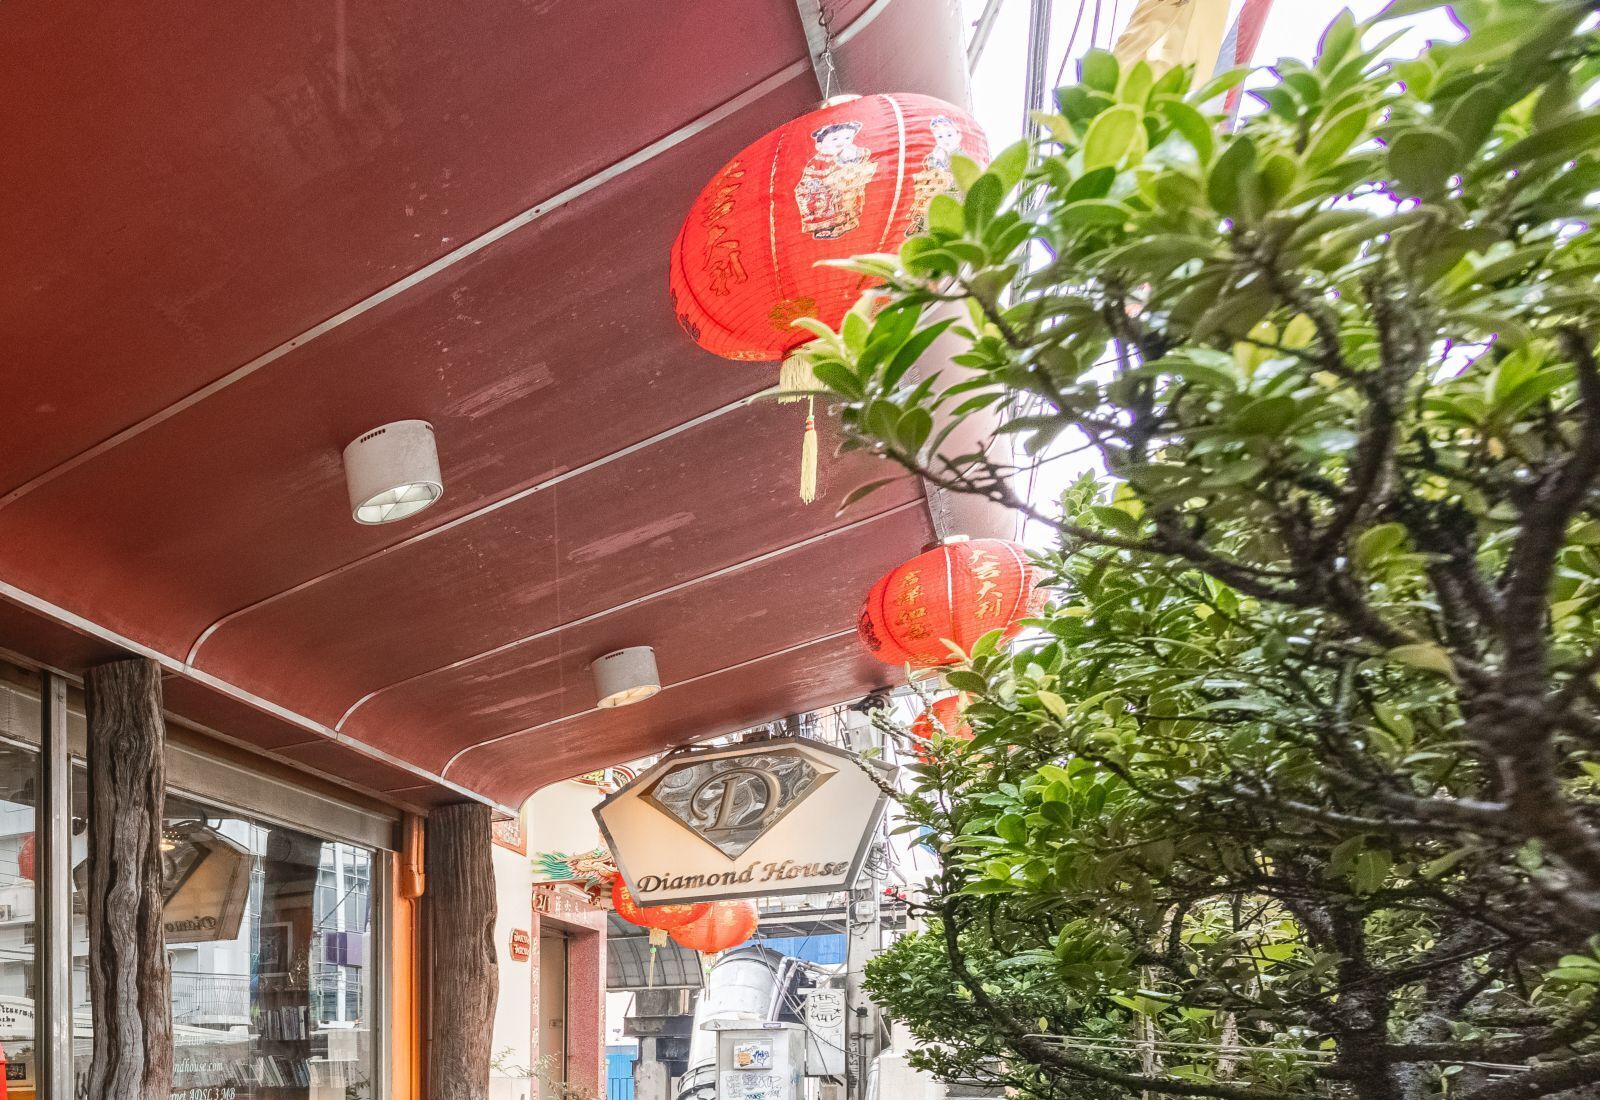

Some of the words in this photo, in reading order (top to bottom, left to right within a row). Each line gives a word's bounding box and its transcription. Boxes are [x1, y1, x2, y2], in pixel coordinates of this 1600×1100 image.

[968, 549, 1004, 620] 大吉大利
[689, 766, 784, 833] D
[637, 861, 760, 892] Diamond
[761, 859, 849, 884] House
[214, 1088, 219, 1100] 3
[220, 1087, 236, 1100] MB
